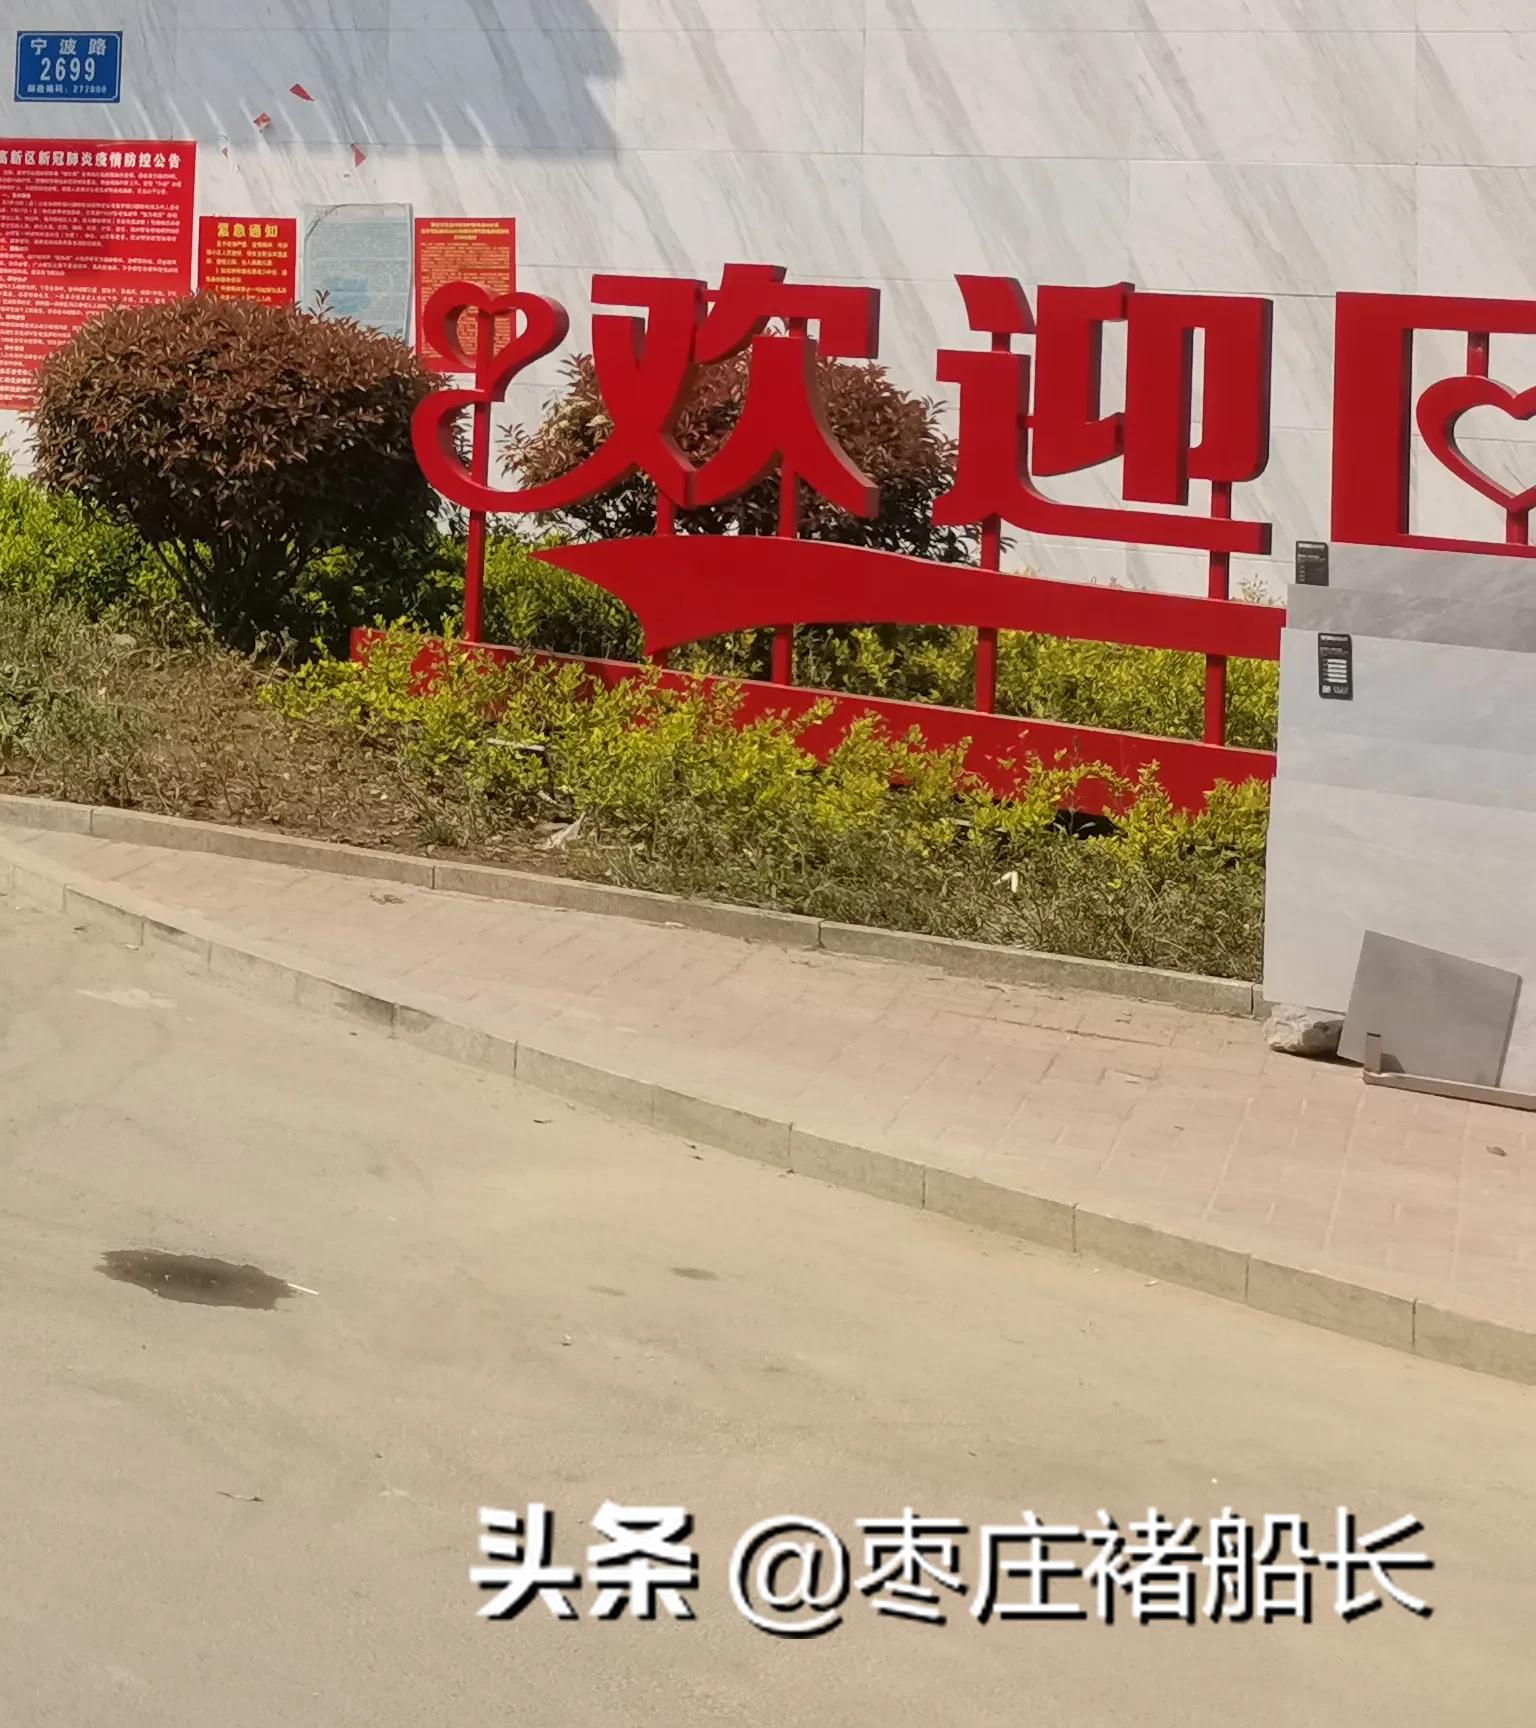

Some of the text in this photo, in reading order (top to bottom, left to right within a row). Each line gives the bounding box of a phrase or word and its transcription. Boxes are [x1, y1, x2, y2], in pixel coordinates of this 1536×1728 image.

[30, 38, 107, 56] 宁波路
[40, 57, 95, 81] 2699
